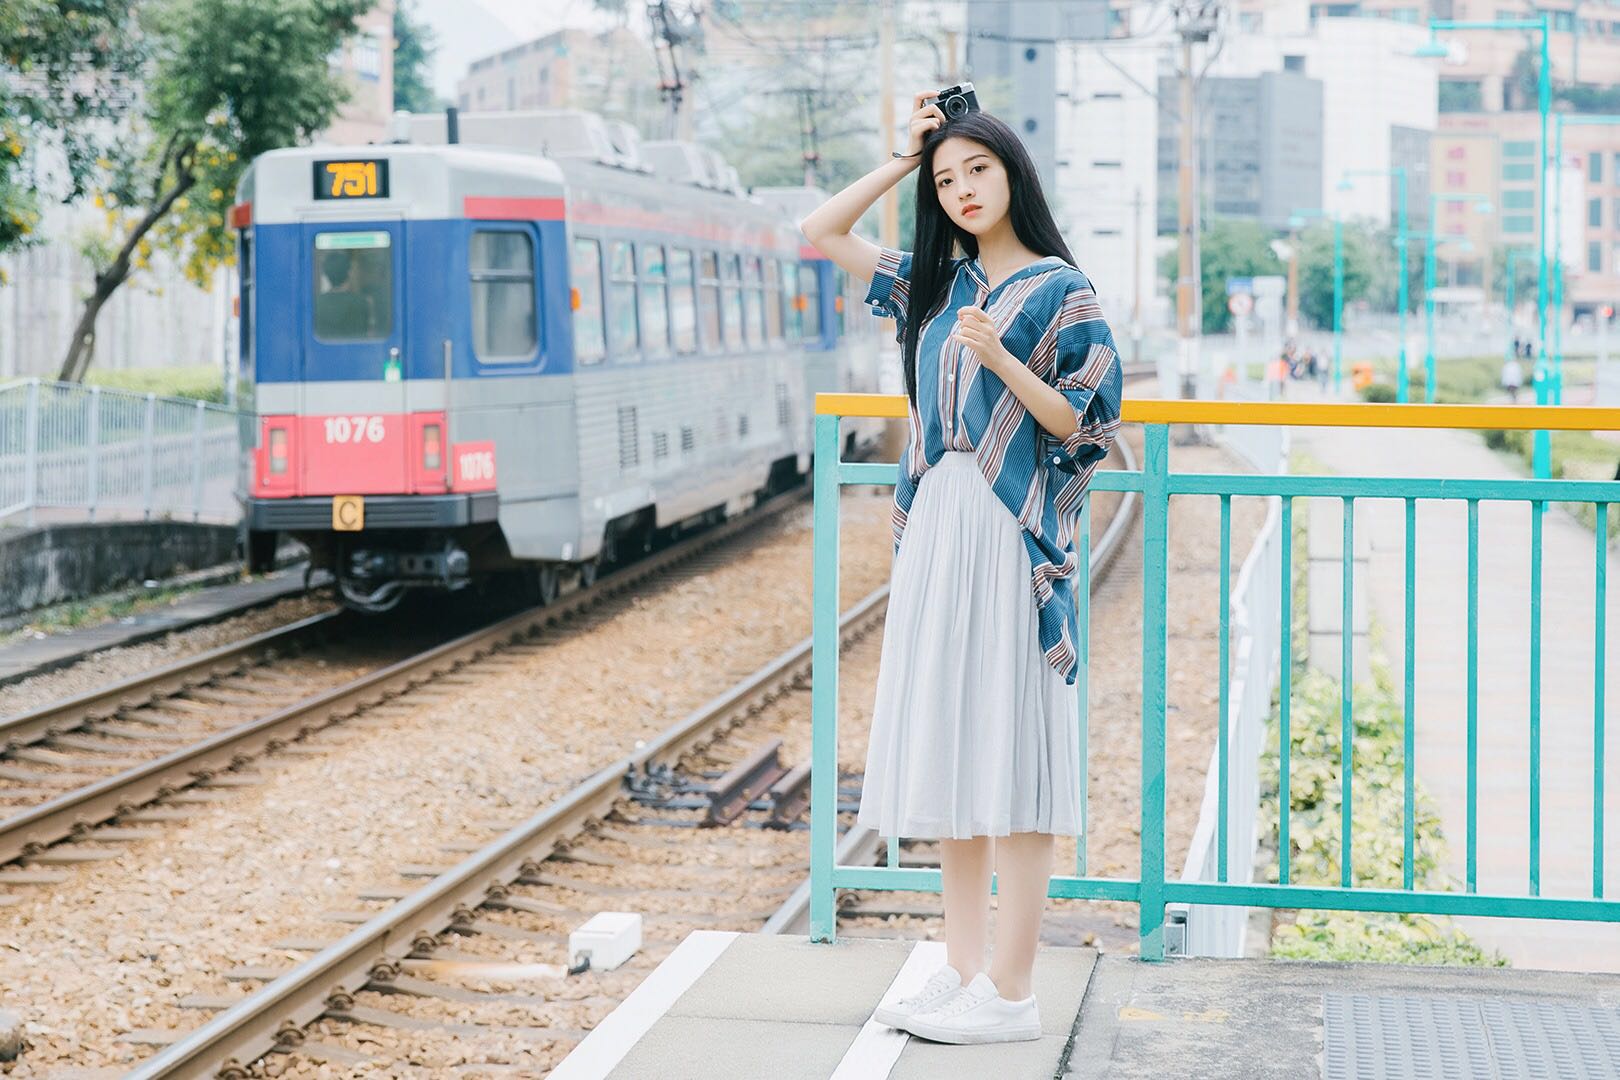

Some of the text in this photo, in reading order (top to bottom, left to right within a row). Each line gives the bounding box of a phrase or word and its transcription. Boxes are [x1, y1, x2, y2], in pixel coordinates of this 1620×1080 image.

[326, 161, 377, 197] 751
[324, 416, 385, 444] 1076
[460, 452, 494, 481] 1076
[339, 501, 357, 526] C
